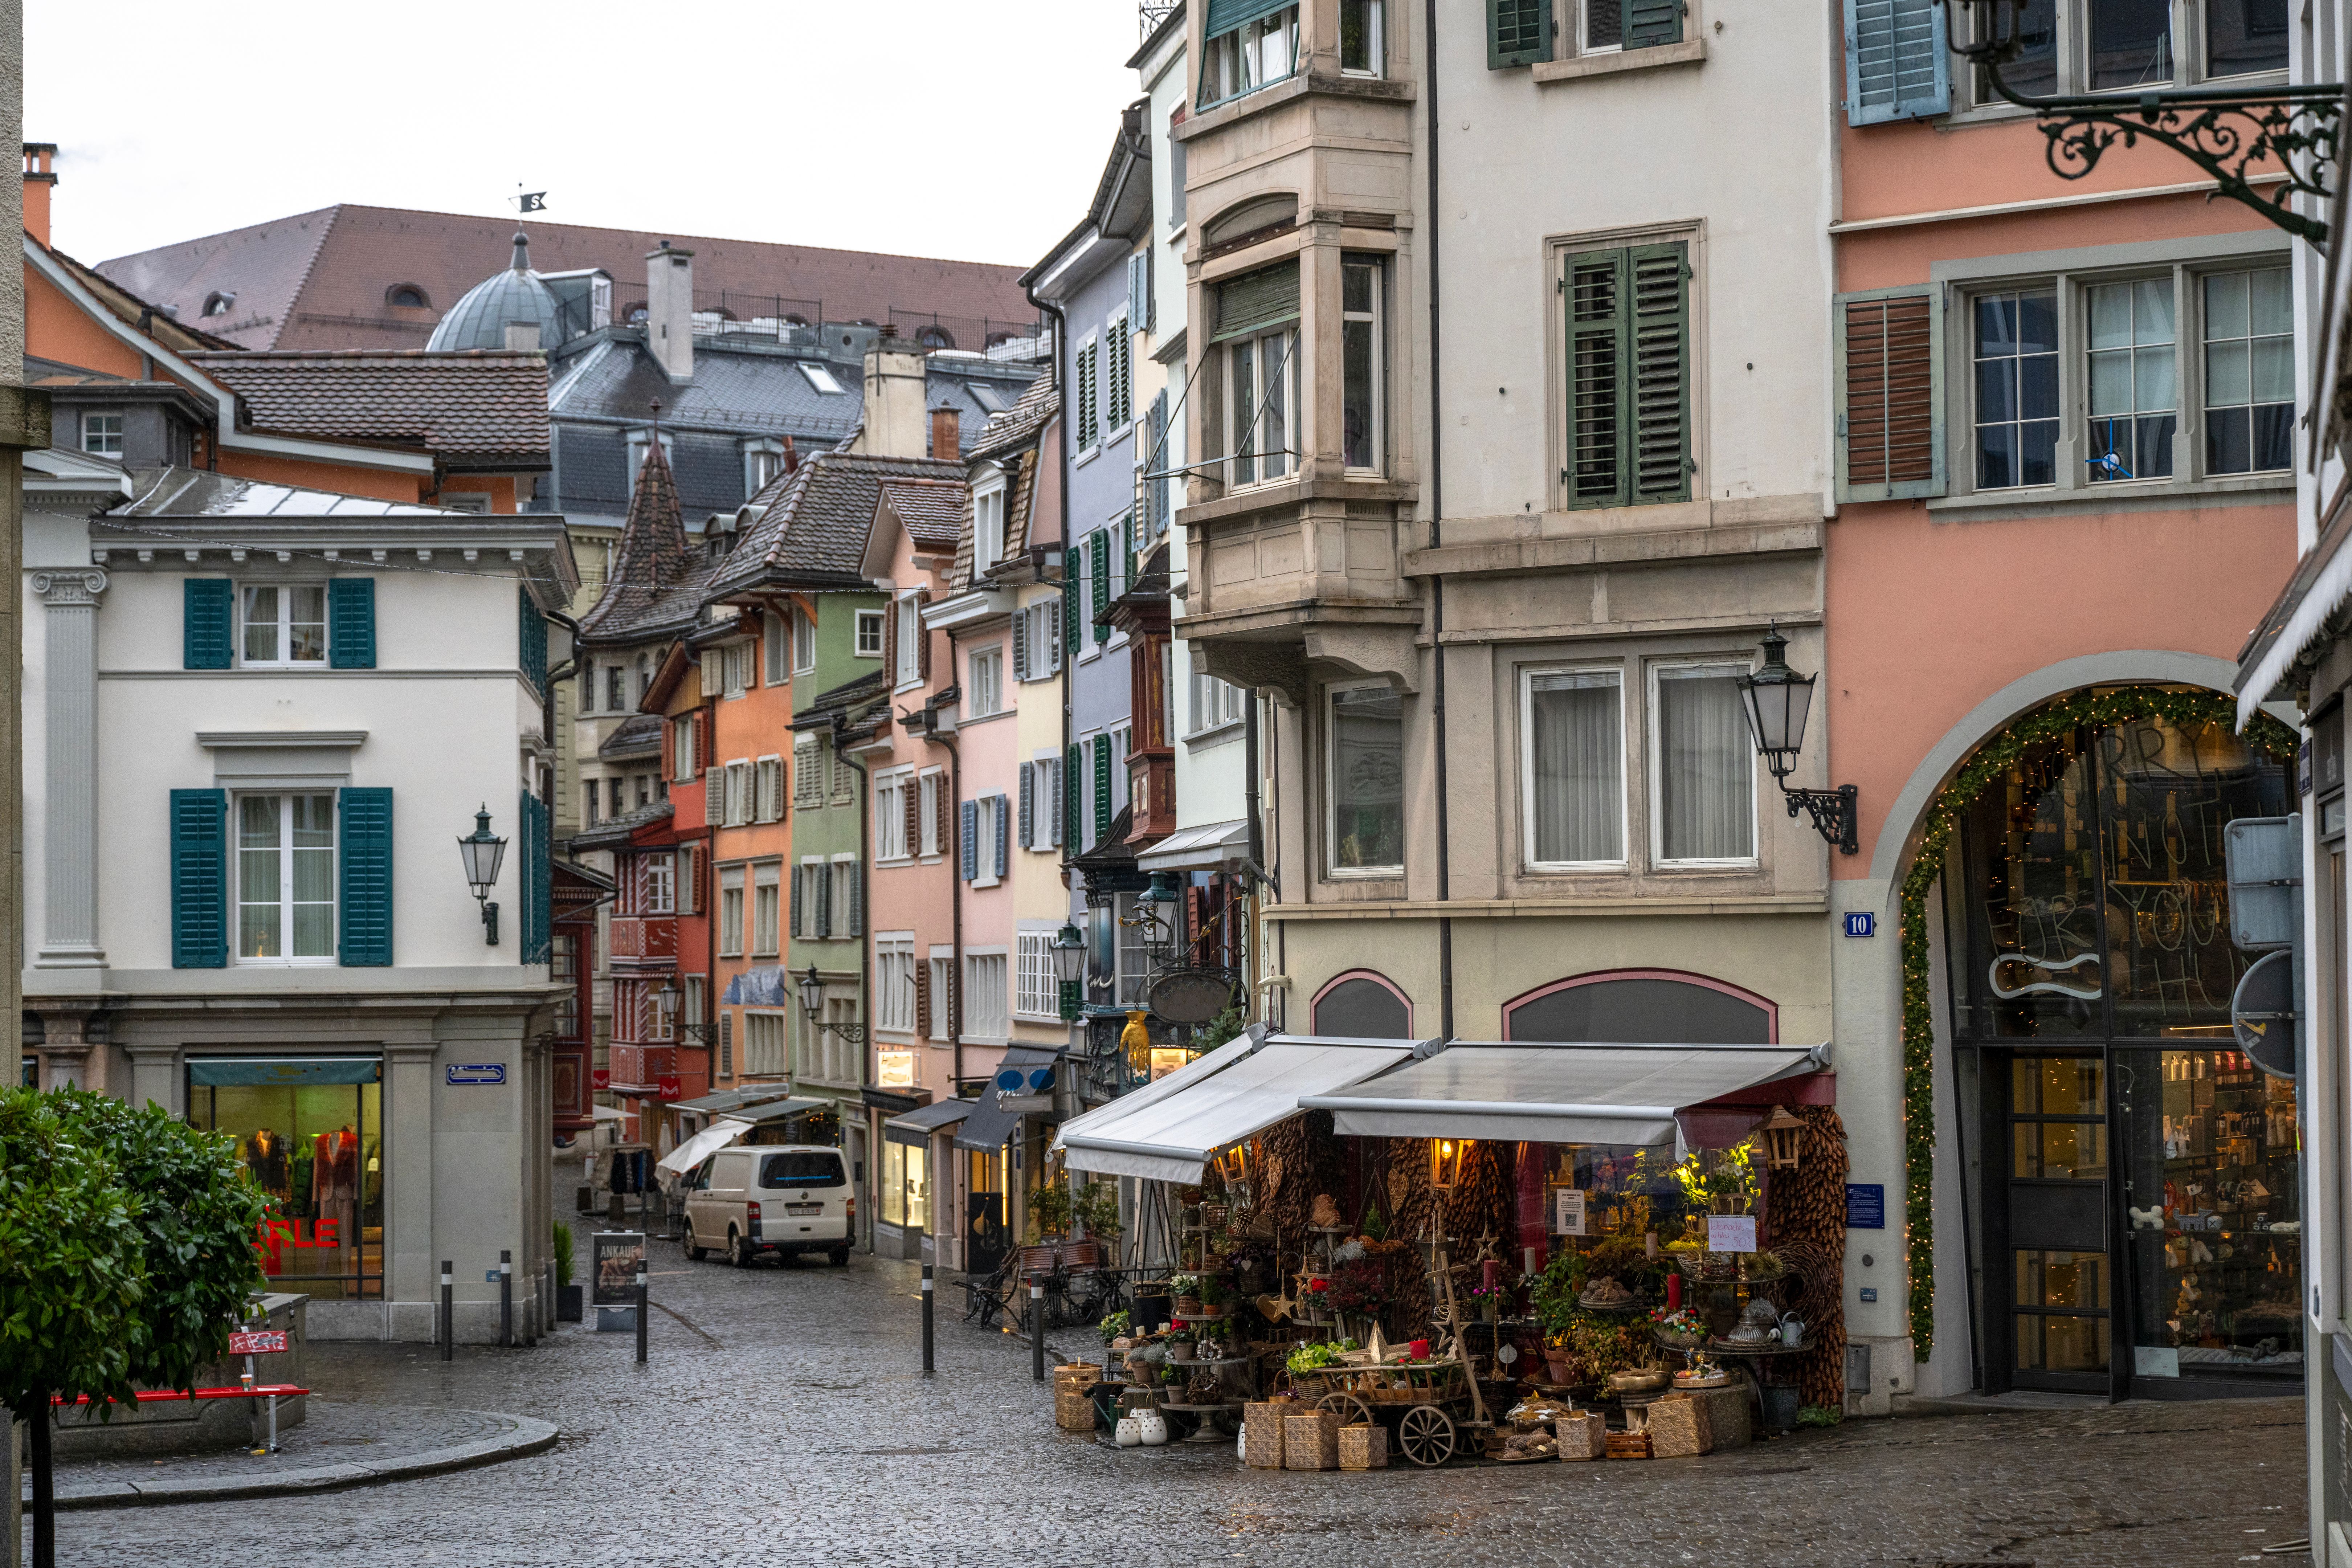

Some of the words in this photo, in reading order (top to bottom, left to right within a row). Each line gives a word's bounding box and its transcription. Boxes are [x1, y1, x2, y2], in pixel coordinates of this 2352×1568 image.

[2110, 788, 2219, 879] NOT
[2108, 880, 2217, 951] YOU
[1851, 916, 1866, 933] 10
[1732, 1237, 1752, 1248] 50%
[600, 1245, 636, 1258] ANKAUF
